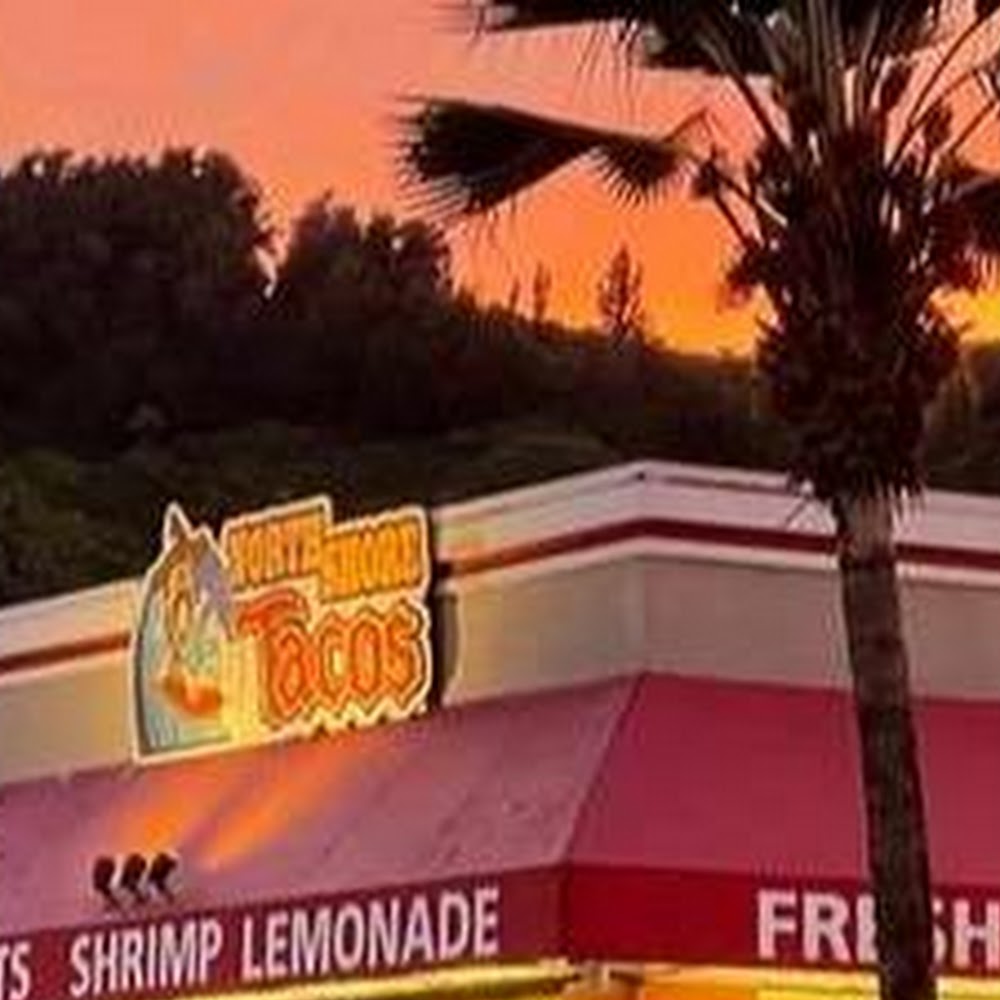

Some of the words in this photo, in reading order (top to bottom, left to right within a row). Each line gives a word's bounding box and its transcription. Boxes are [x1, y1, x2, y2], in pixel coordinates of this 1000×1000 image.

[235, 585, 426, 731] Tacos
[69, 918, 223, 998] SHRIMP
[241, 886, 500, 981] LEMONADE
